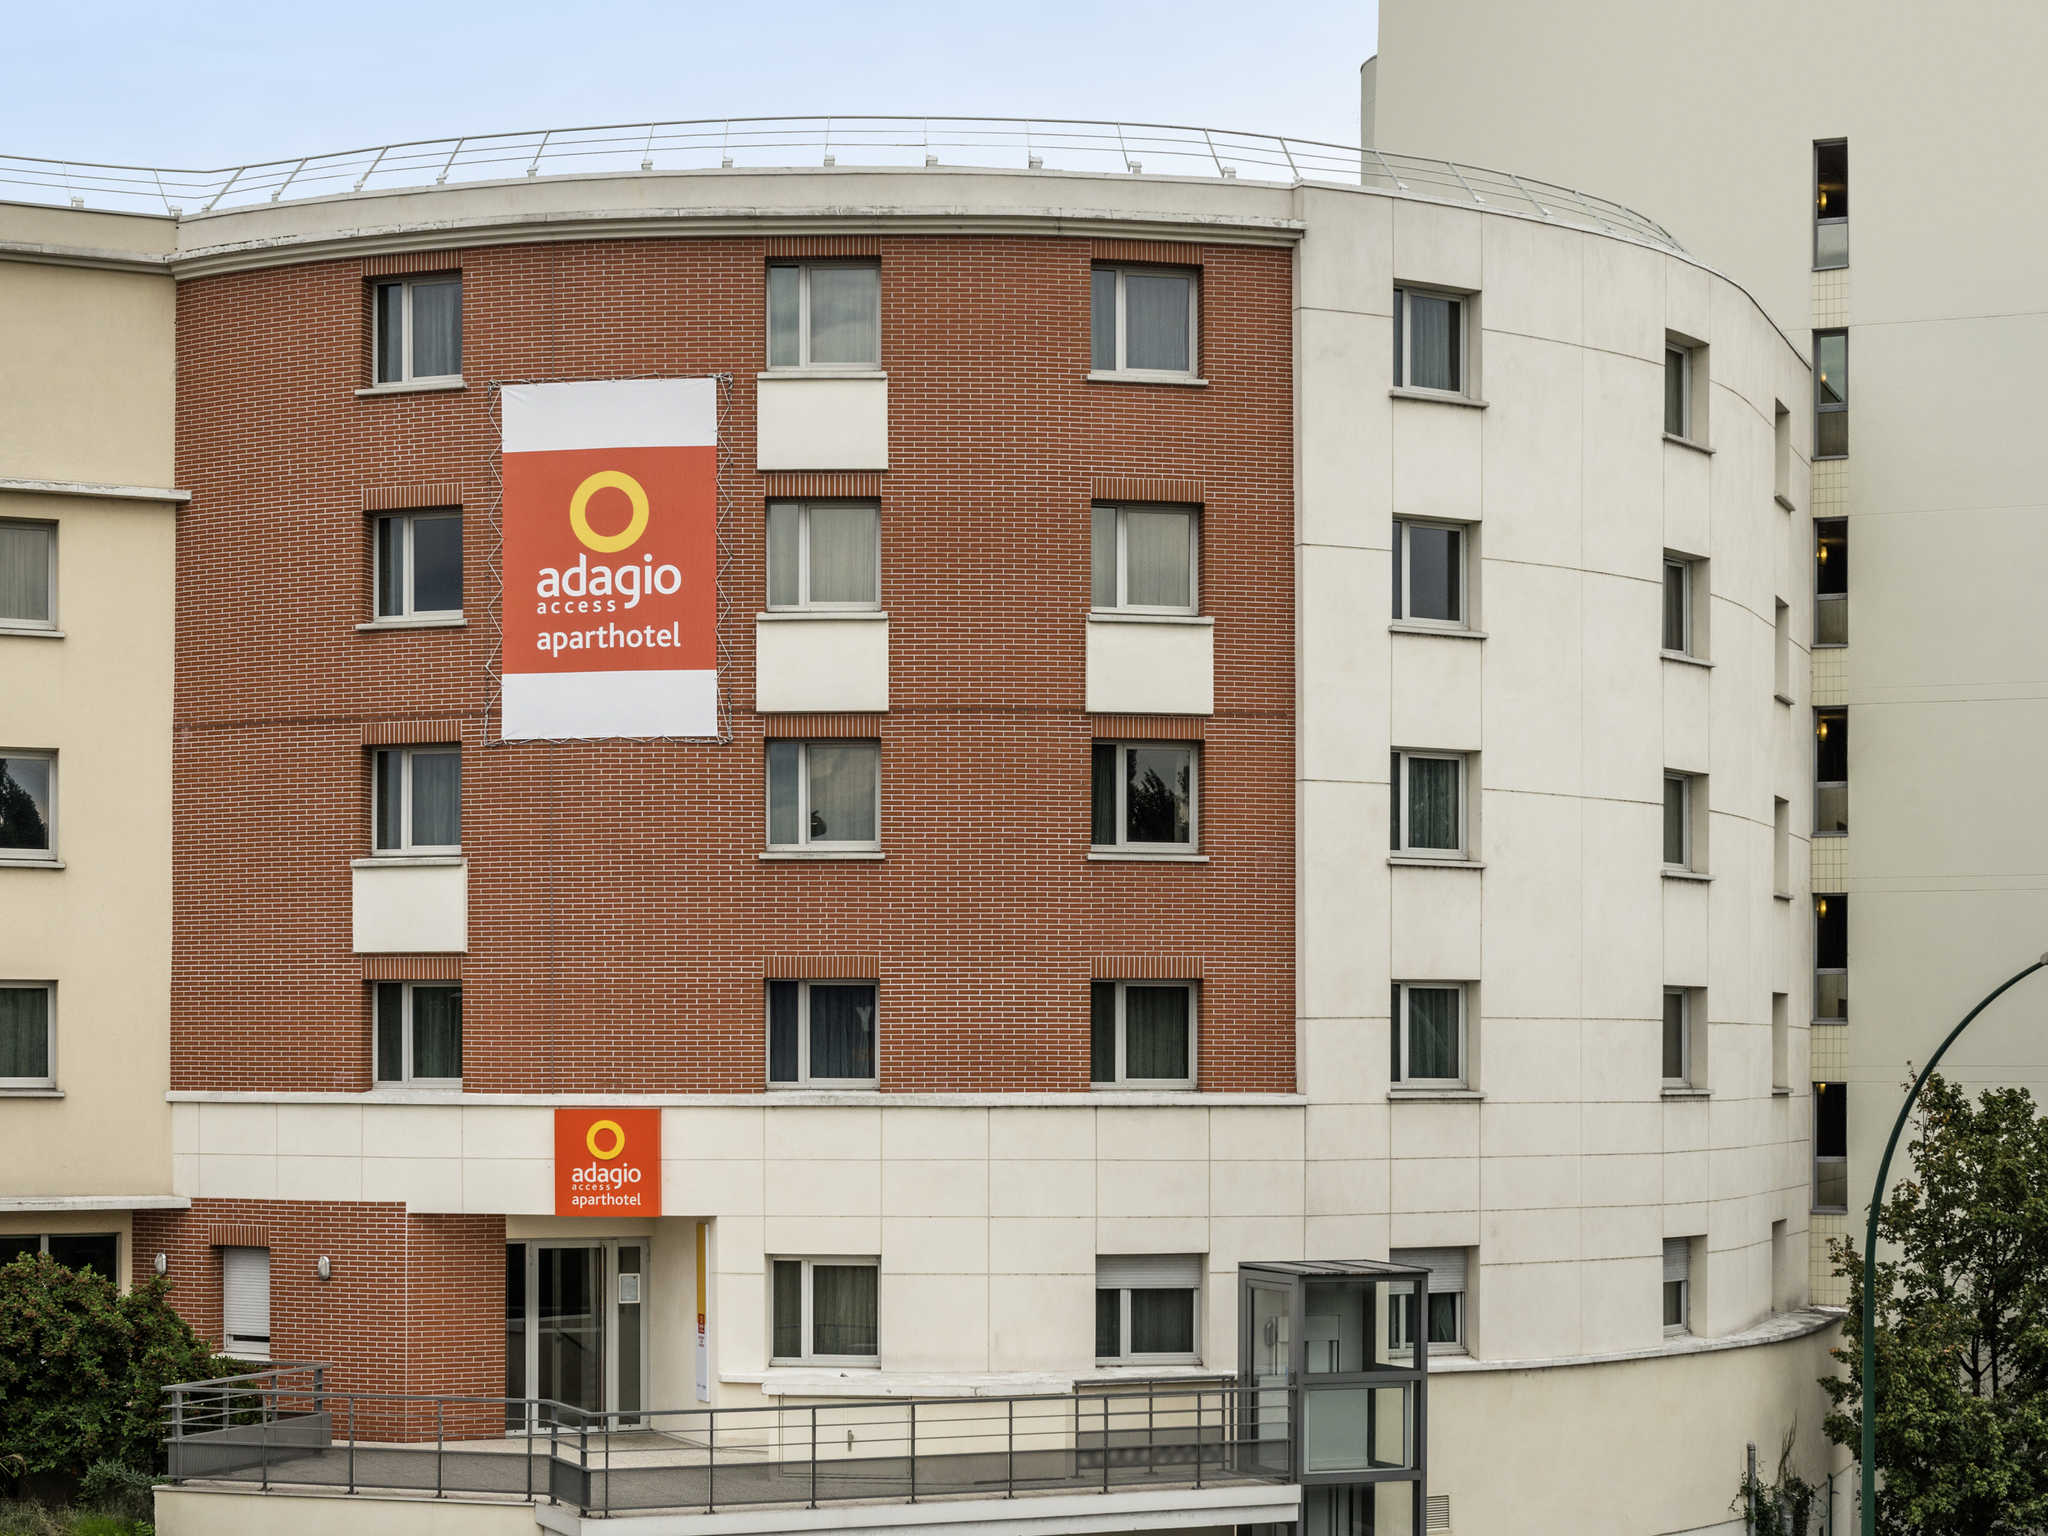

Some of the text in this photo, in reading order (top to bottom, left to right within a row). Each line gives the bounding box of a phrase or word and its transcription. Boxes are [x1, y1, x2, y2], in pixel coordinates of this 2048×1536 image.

[536, 553, 682, 609] adagio
[536, 600, 616, 615] access
[536, 621, 681, 657] aparthotel
[572, 1162, 641, 1189] adagio
[572, 1192, 641, 1208] aparthotel
